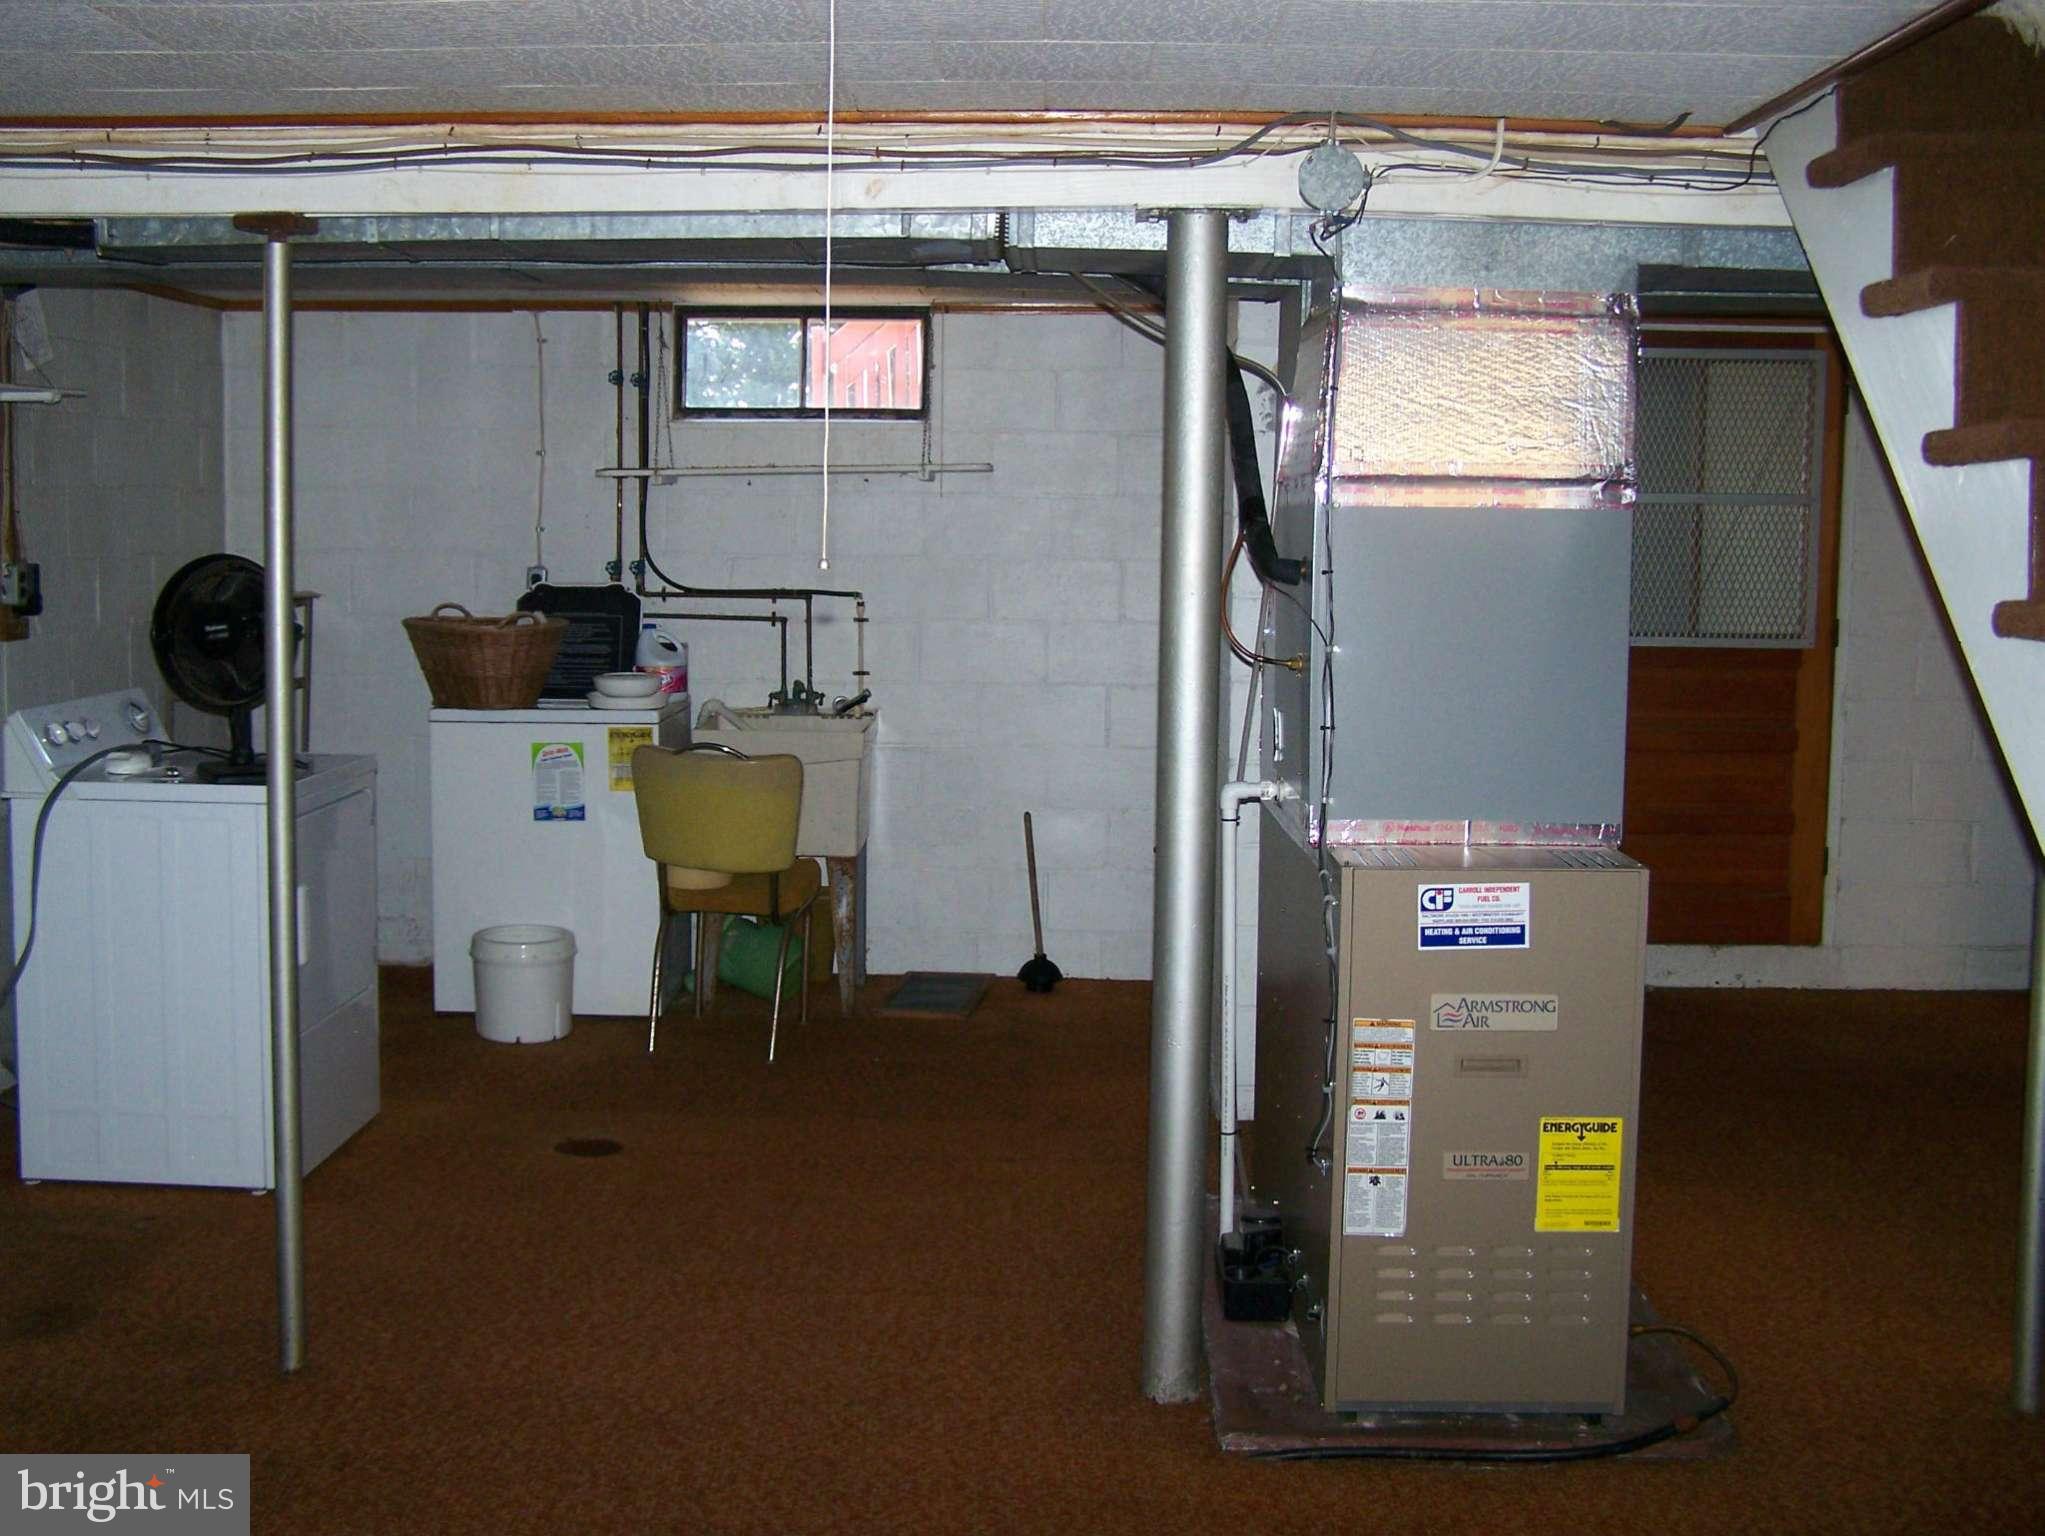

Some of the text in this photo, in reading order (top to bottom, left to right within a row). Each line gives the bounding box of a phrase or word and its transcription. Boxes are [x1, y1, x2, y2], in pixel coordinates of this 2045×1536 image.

[1424, 928, 1453, 936] HEATING
[1461, 927, 1473, 935] AIR
[1474, 926, 1521, 935] CONDITIONING
[1458, 936, 1487, 944] SERVICE
[1456, 998, 1556, 1013] ARMSTRONG
[1543, 1122, 1617, 1133] ENERGYGUIDE
